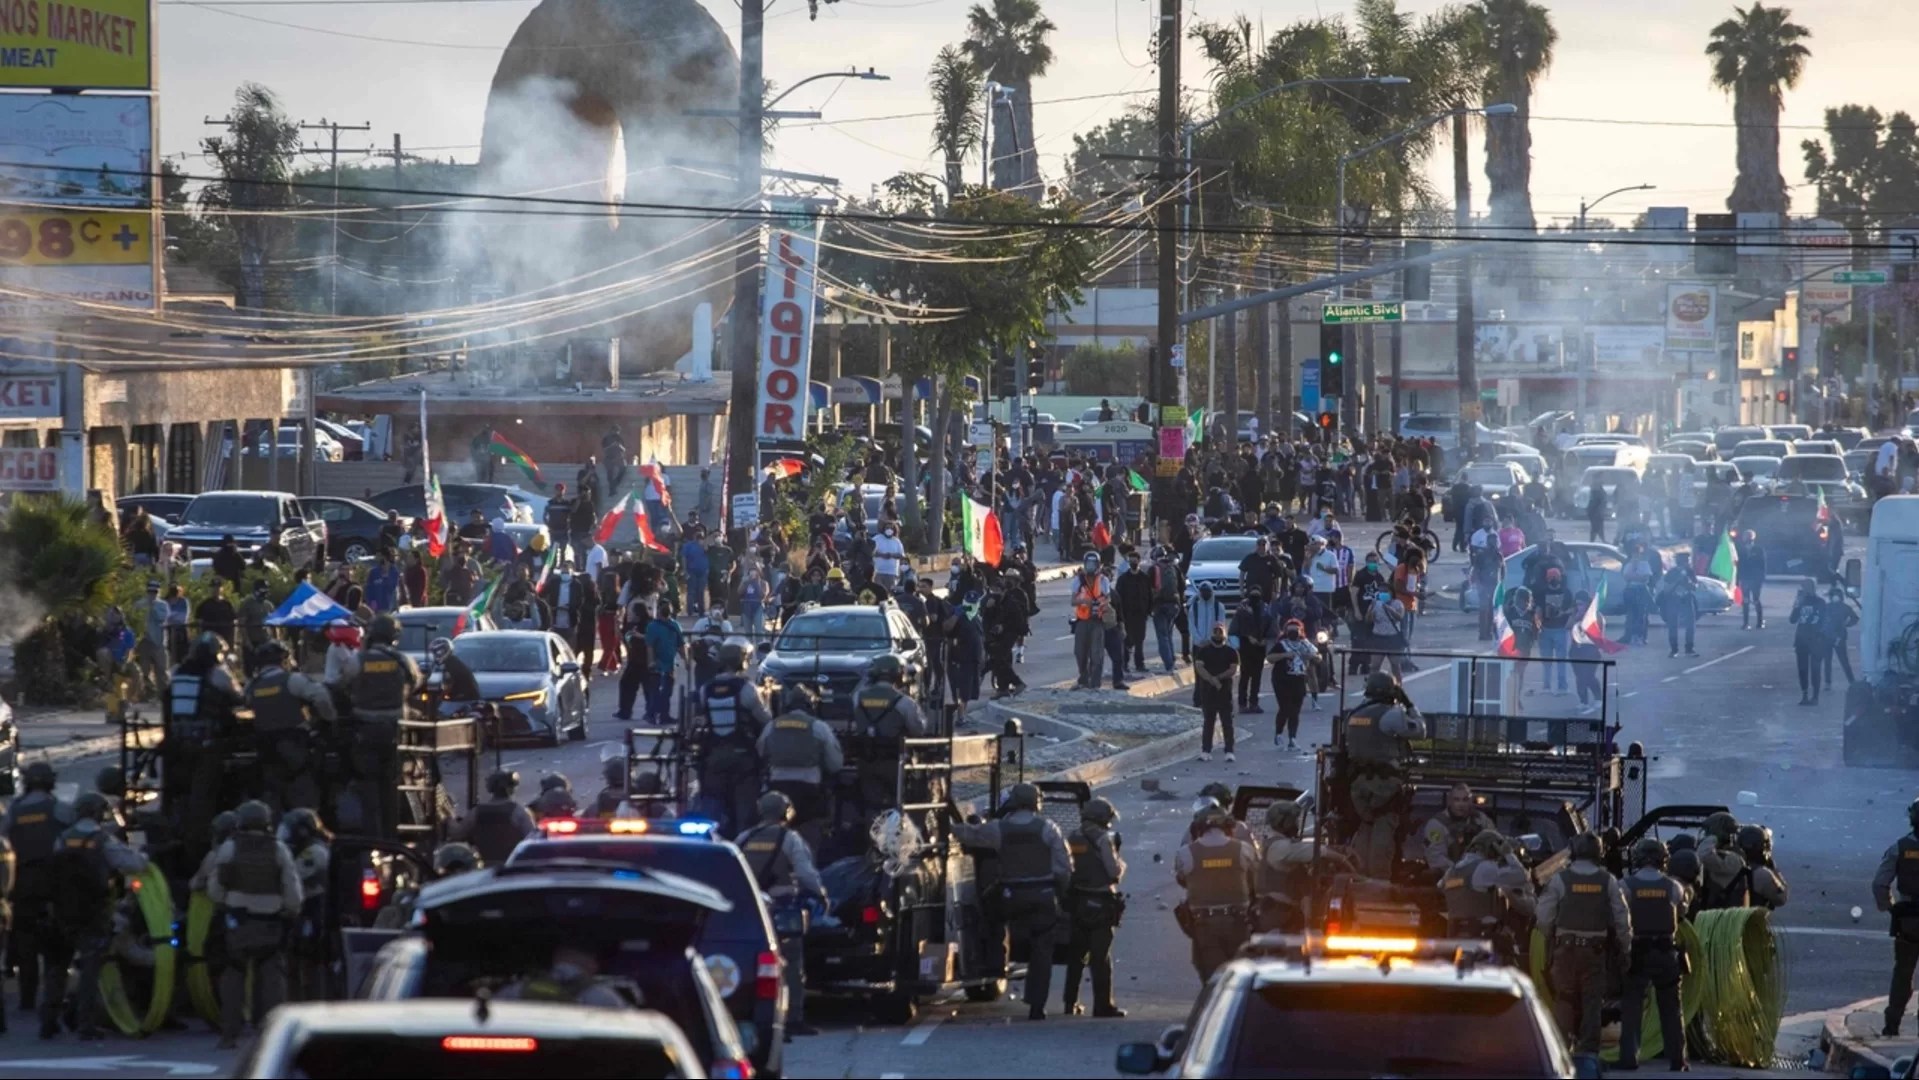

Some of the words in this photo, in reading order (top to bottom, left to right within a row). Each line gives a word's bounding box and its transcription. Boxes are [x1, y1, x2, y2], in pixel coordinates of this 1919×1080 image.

[47, 1, 137, 57] MARKET
[1, 47, 57, 68] MEAT
[1325, 305, 1370, 317] Atlantic
[1372, 303, 1399, 315] Blvd
[764, 233, 804, 435] LIQUOR
[1202, 858, 1233, 868] SHERIFF
